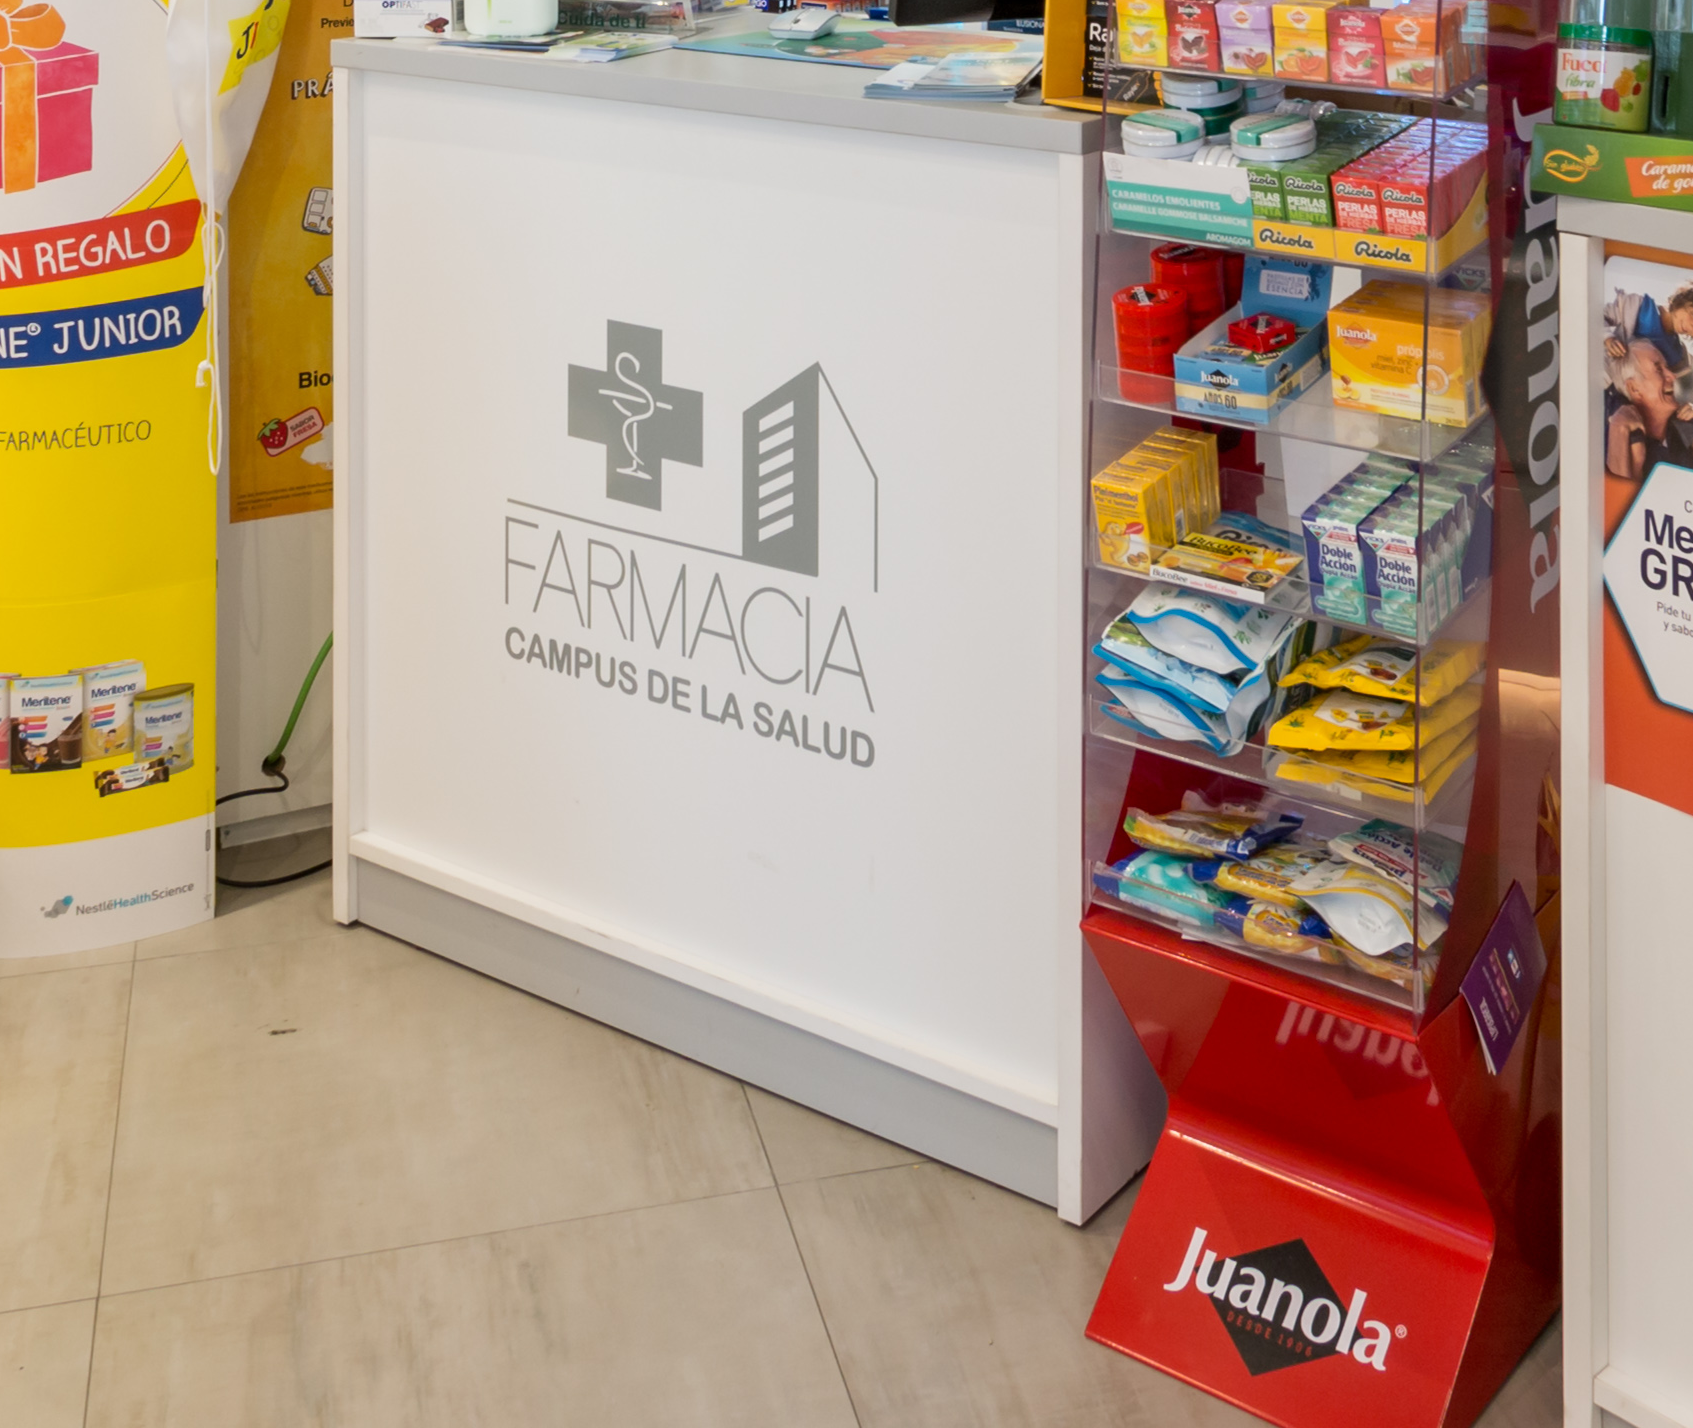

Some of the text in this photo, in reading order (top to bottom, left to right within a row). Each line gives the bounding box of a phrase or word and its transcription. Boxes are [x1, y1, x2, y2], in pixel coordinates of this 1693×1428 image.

[1652, 175, 1668, 191] de
[37, 219, 170, 275] REGALO
[1260, 229, 1314, 249] Ricola
[53, 306, 181, 354] JUNIOR
[1321, 544, 1353, 560] Doble
[1321, 557, 1356, 574] Accion
[505, 516, 875, 713] FARMACIA
[1657, 600, 1676, 616] Pide
[505, 626, 875, 768] CAMPUS DE LA SALUD
[1164, 1227, 1388, 1372] Juanola
